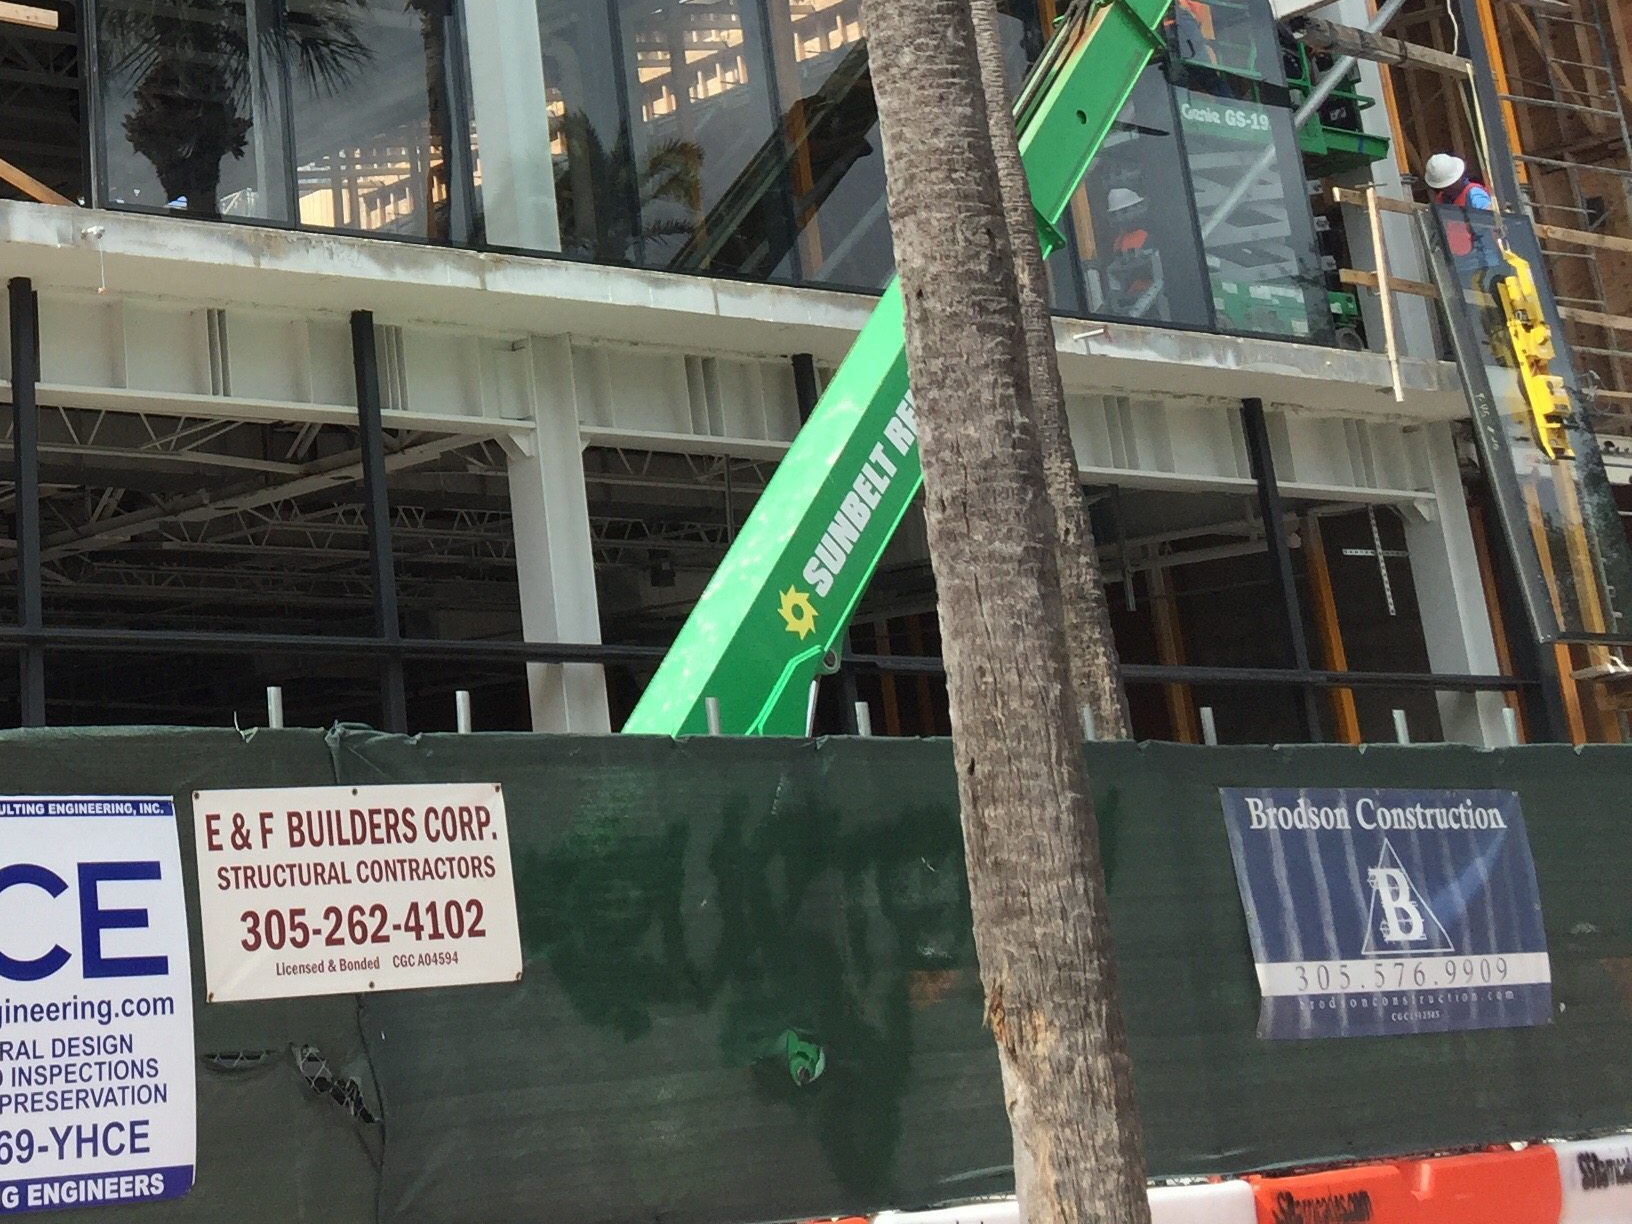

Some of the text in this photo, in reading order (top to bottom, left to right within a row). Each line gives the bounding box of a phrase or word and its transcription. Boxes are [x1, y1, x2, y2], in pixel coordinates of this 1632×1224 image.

[802, 389, 918, 598] SUNBELT RE
[48, 803, 137, 817] ENGINEERING,
[140, 803, 164, 815] INC.
[1245, 798, 1507, 830] Brodson Construction
[205, 805, 498, 852] E & F BUILDERS CORP.
[217, 855, 496, 890] STRUCTURAL CONTRACTORS
[240, 898, 486, 952] 305-262-4102
[275, 959, 325, 976] Licensed
[327, 959, 337, 972] &
[339, 956, 380, 972] Bonded
[52, 1034, 134, 1059] DESIGN
[11, 1058, 159, 1088] INSPECTIONS
[27, 1173, 166, 1209] ENGINEERS
